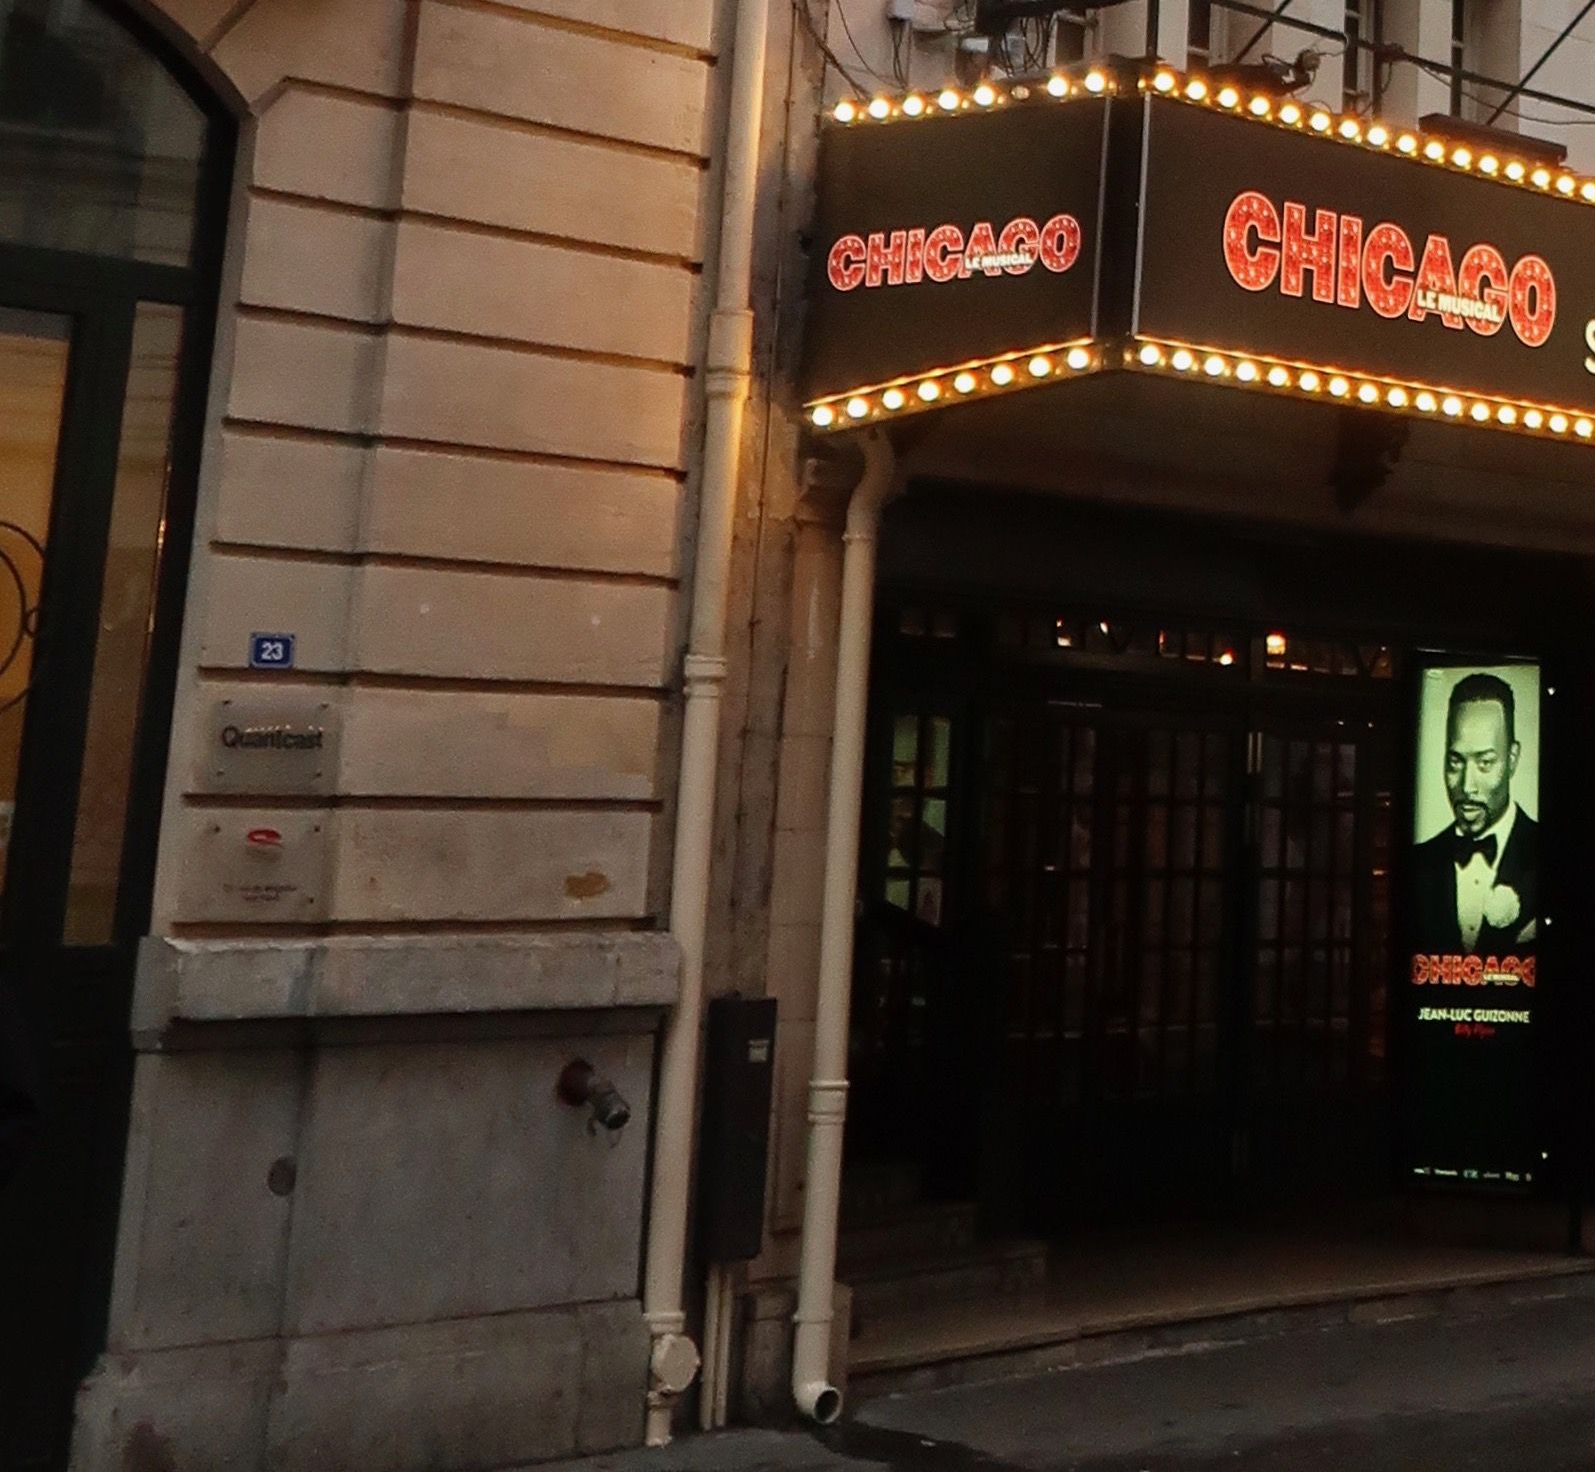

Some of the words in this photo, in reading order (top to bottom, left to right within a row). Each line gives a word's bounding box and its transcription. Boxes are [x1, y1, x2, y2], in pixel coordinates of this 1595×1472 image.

[827, 213, 1082, 292] CHICAGO
[981, 251, 1035, 269] MUSICAL
[1222, 189, 1557, 348] CHICAGO
[1416, 290, 1439, 311] LE
[1438, 294, 1503, 324] MUSICAL
[260, 643, 283, 661] 23
[221, 724, 323, 750] Quantcast
[1417, 1007, 1473, 1022] JEAN-LUC
[1473, 1008, 1531, 1023] GUIZONNE
